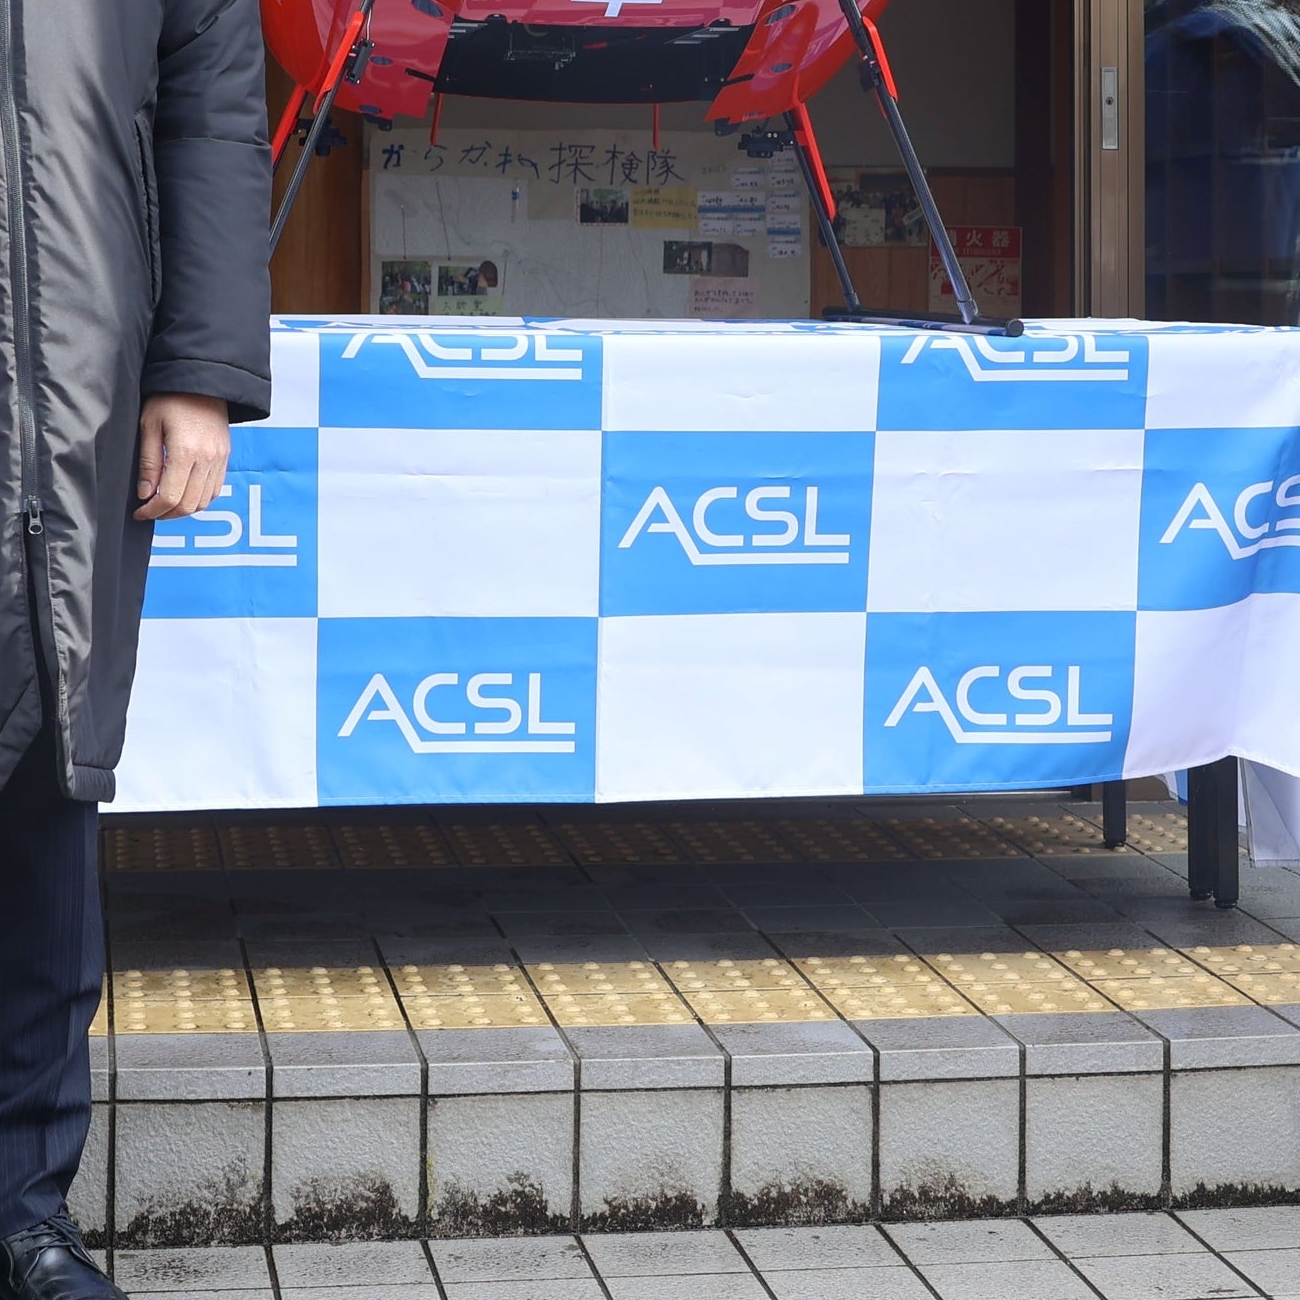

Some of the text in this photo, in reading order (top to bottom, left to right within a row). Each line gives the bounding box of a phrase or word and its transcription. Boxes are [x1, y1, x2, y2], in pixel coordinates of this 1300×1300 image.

[618, 486, 851, 565] ACSL
[337, 672, 576, 753] ACSL
[883, 665, 1113, 743] ACSL
